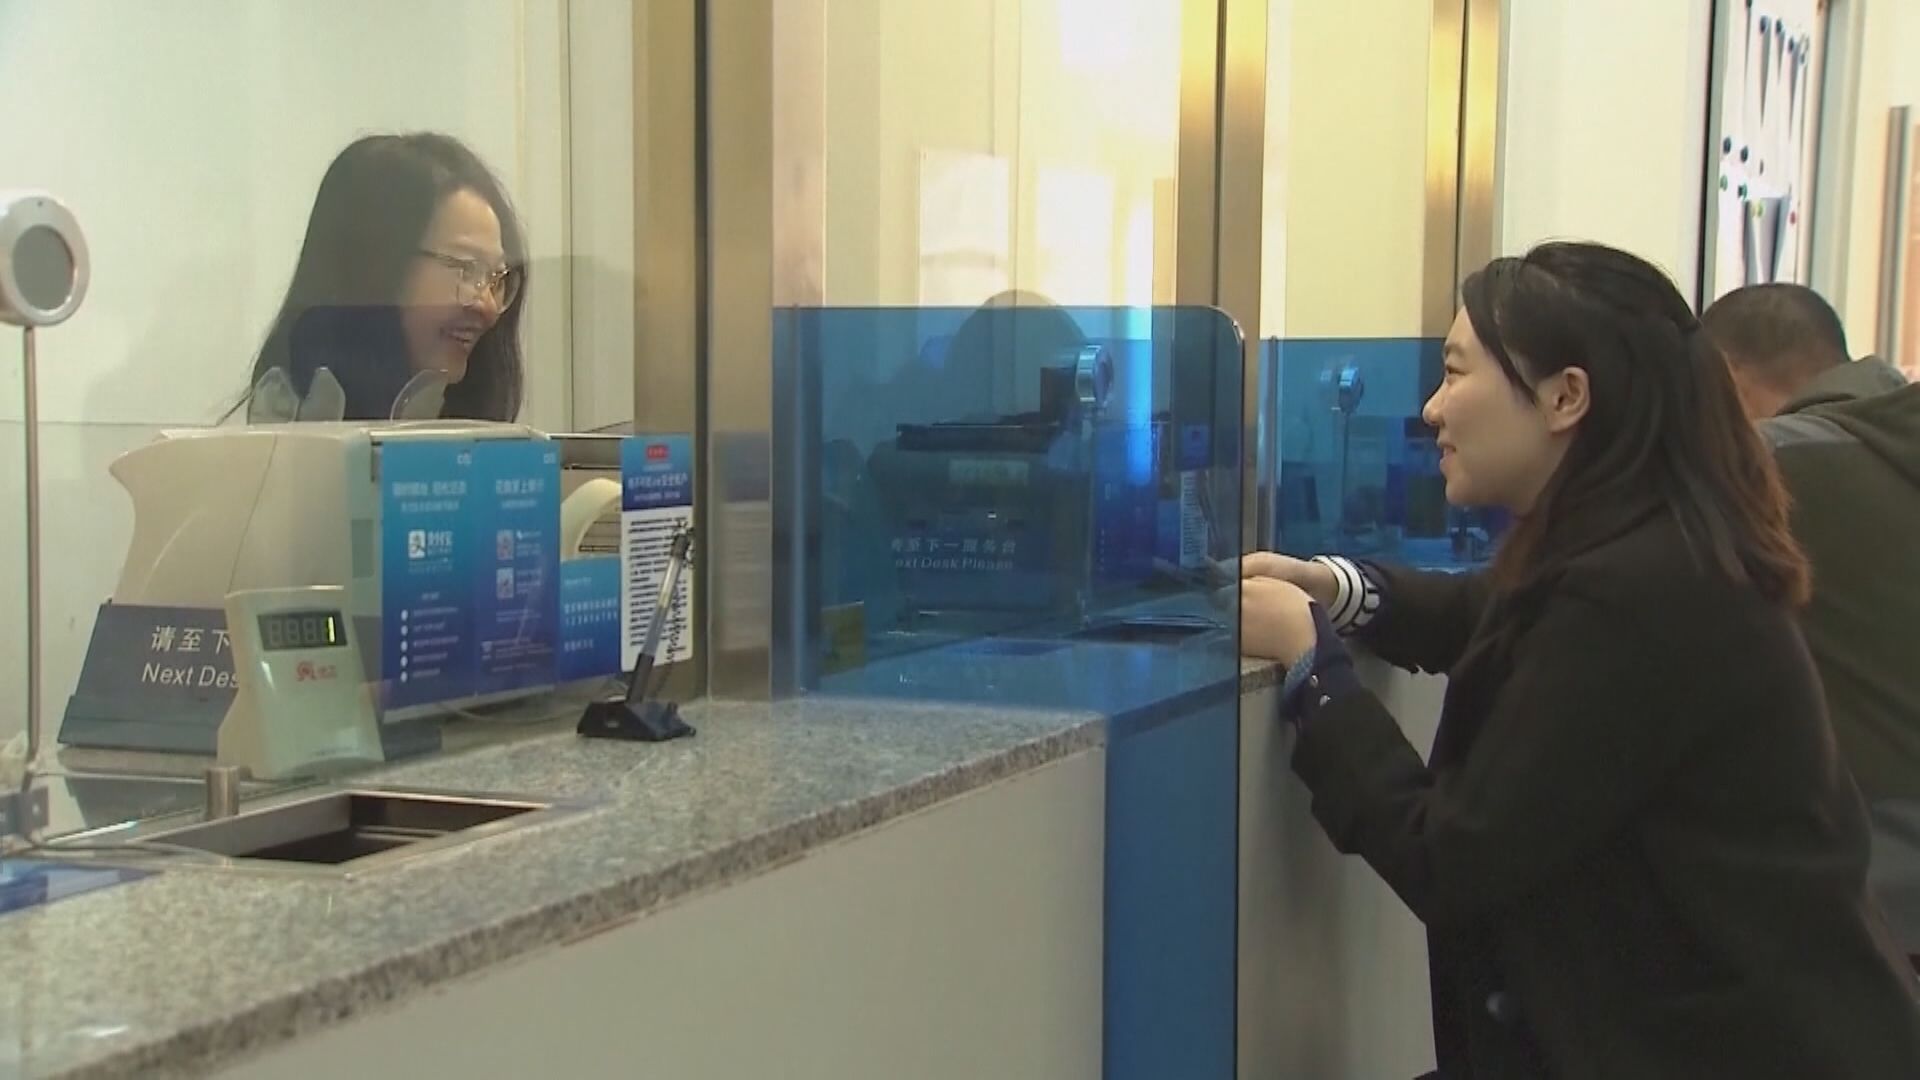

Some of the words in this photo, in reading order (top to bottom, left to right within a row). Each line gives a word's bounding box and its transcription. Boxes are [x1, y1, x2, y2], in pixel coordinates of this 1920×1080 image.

[920, 557, 958, 569] Desk
[151, 624, 231, 655] 请至下
[141, 662, 193, 687] Next
